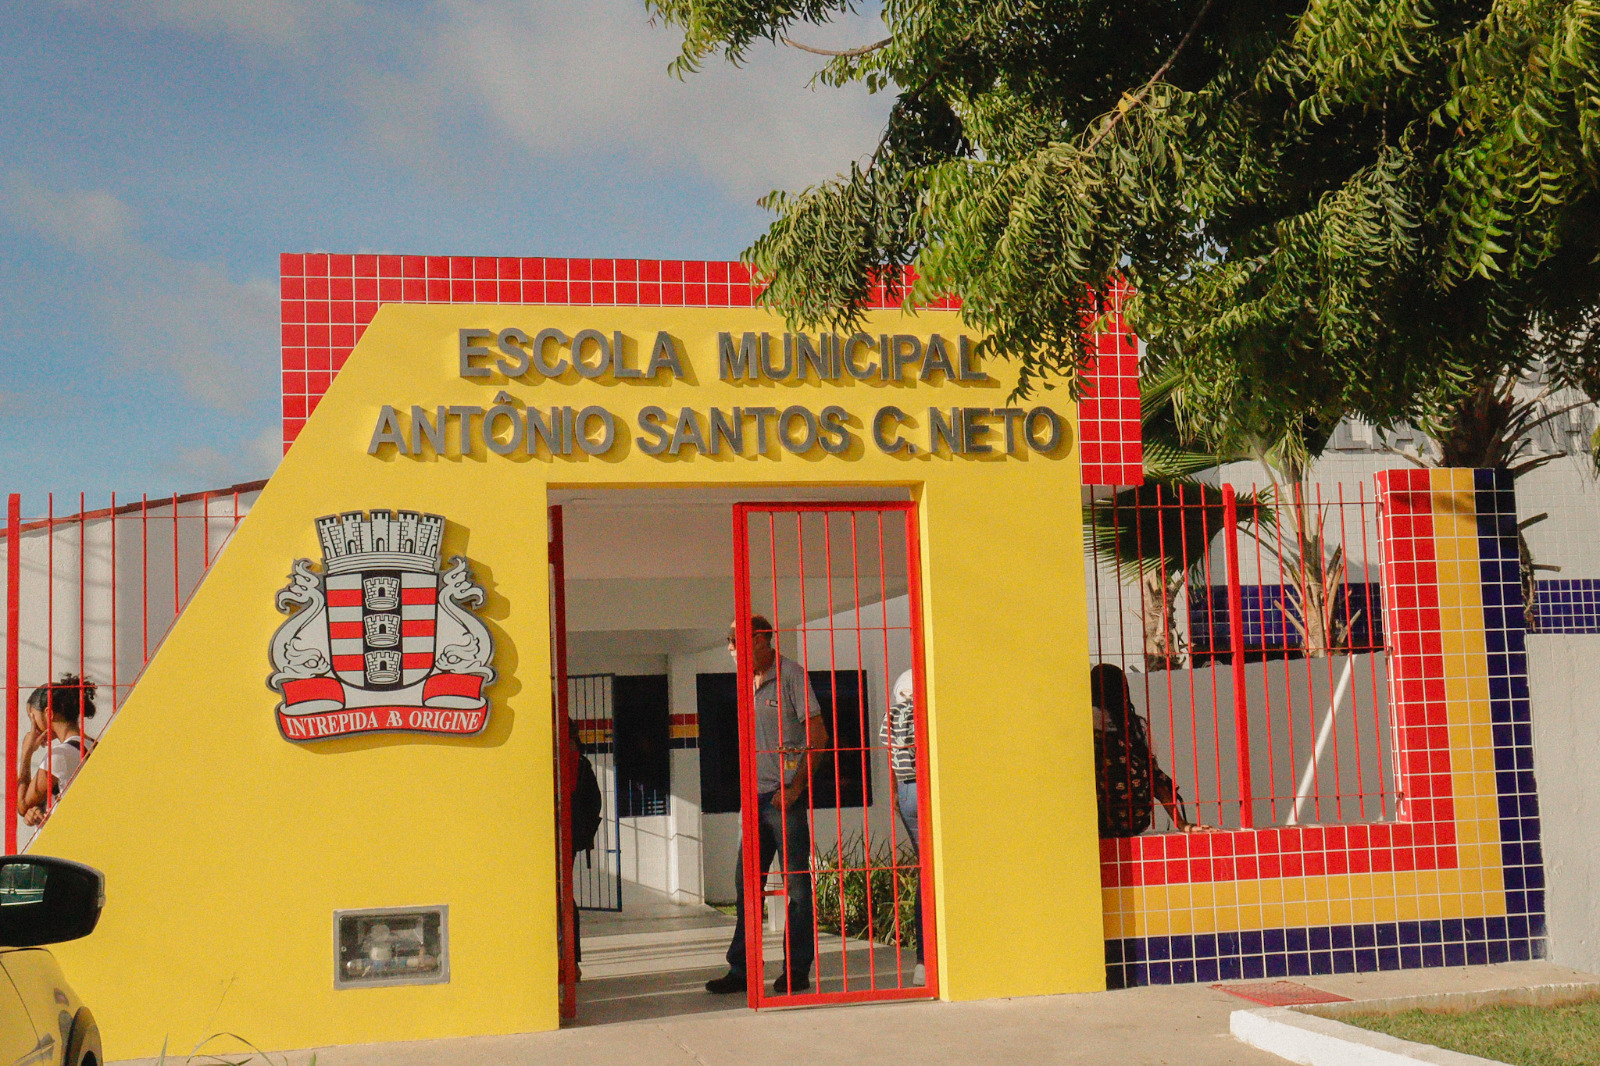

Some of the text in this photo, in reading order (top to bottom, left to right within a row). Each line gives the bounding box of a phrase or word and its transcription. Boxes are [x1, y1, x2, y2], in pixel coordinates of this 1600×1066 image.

[460, 328, 987, 380] ESCOLA MUNICIPAL
[367, 390, 1060, 455] ANTÔNIO SANTOS C. NETO
[285, 710, 482, 737] INTREPIDA AB ORIGINE
